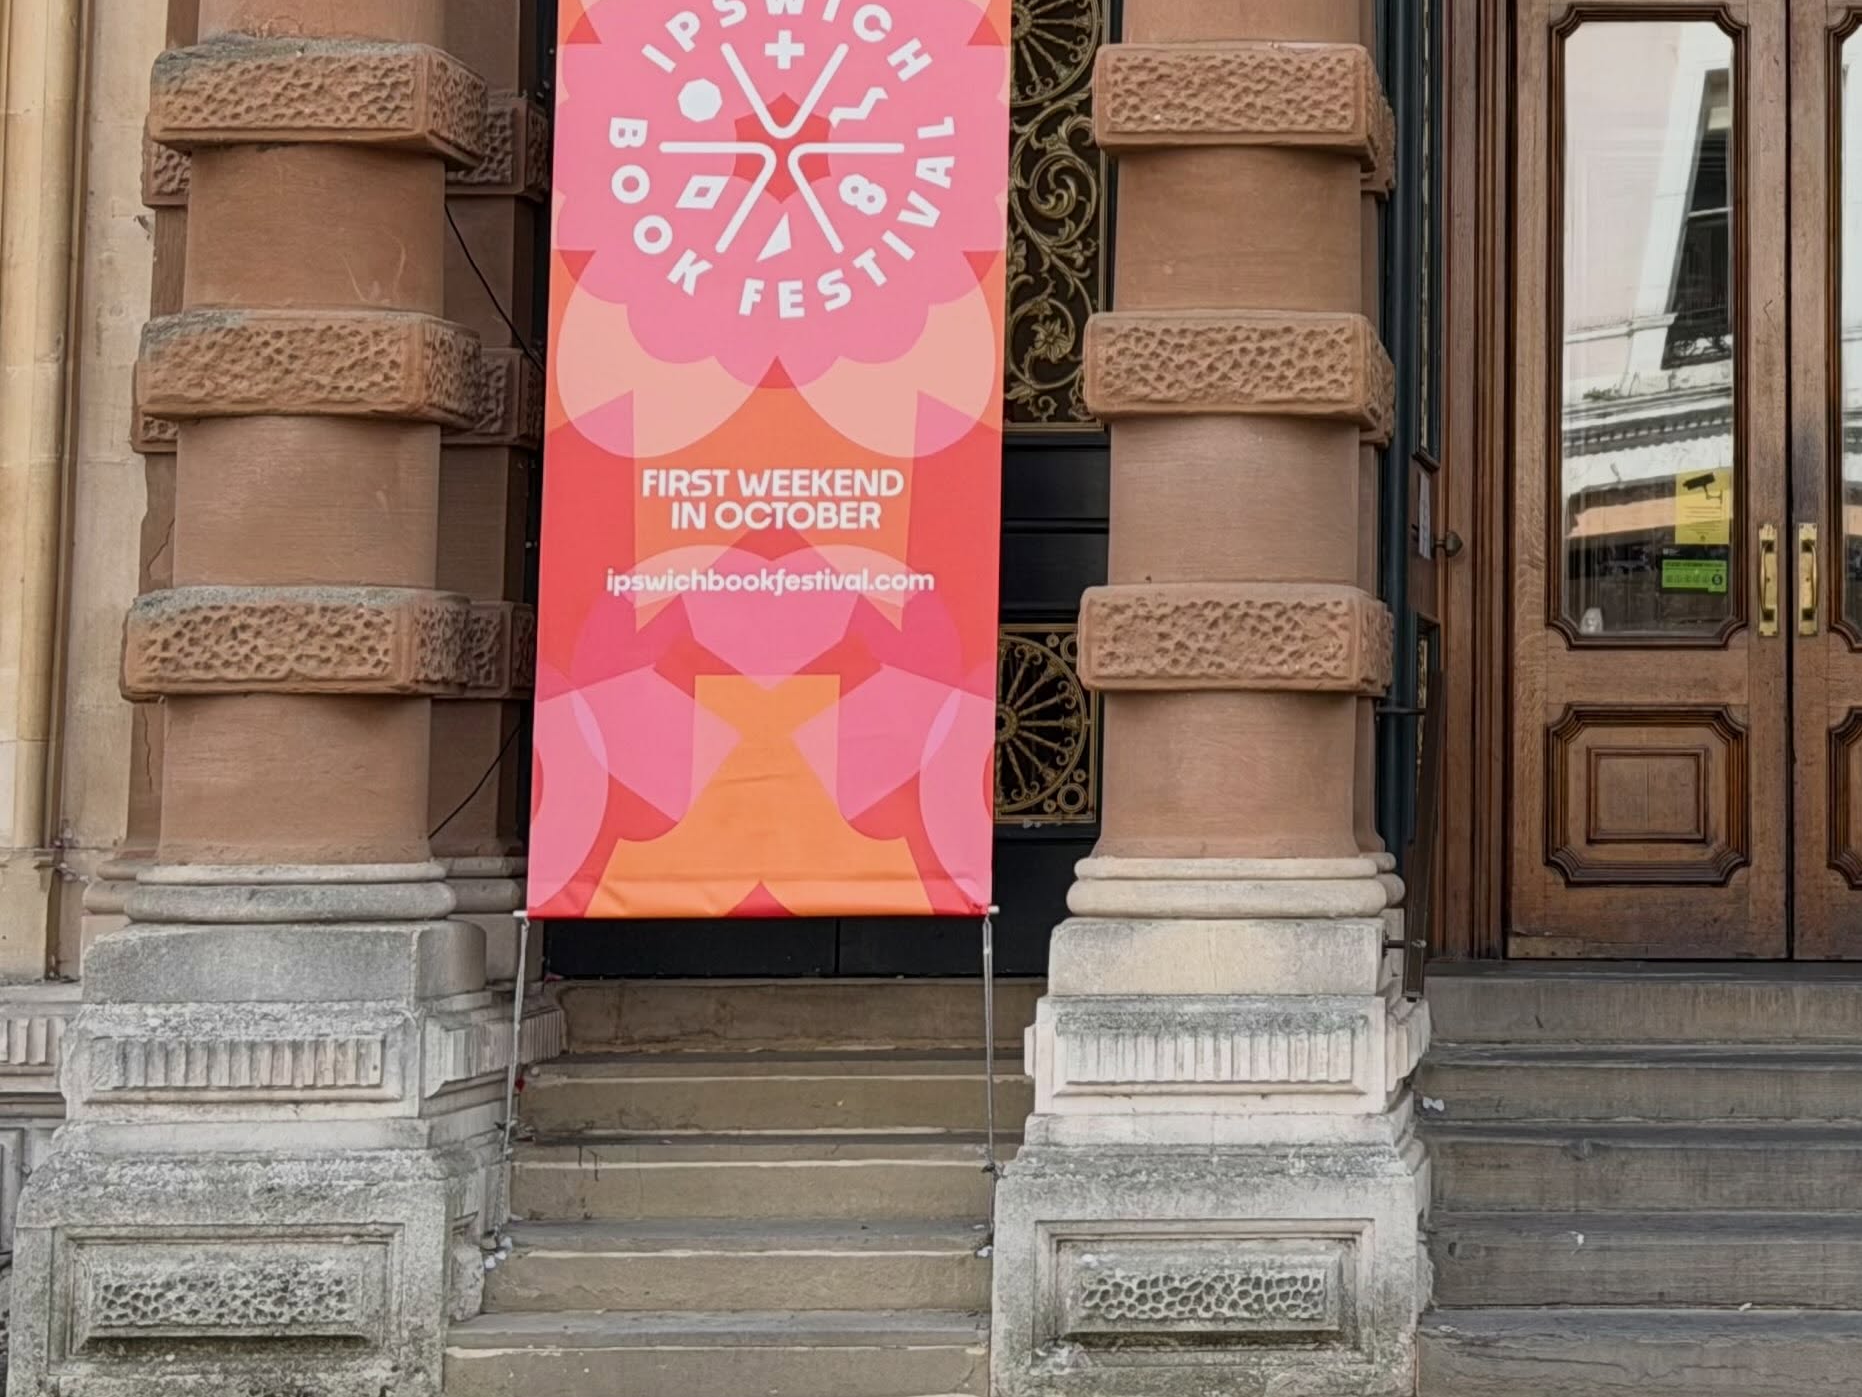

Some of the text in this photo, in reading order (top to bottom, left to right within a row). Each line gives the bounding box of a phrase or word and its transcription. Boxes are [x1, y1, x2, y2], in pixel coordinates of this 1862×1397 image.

[609, 116, 955, 319] BOOK FESTIVAL
[642, 469, 904, 497] FIRST WEEKEND
[671, 501, 880, 530] IN OCTOBER
[606, 568, 935, 596] ipswichbookfestival.com
